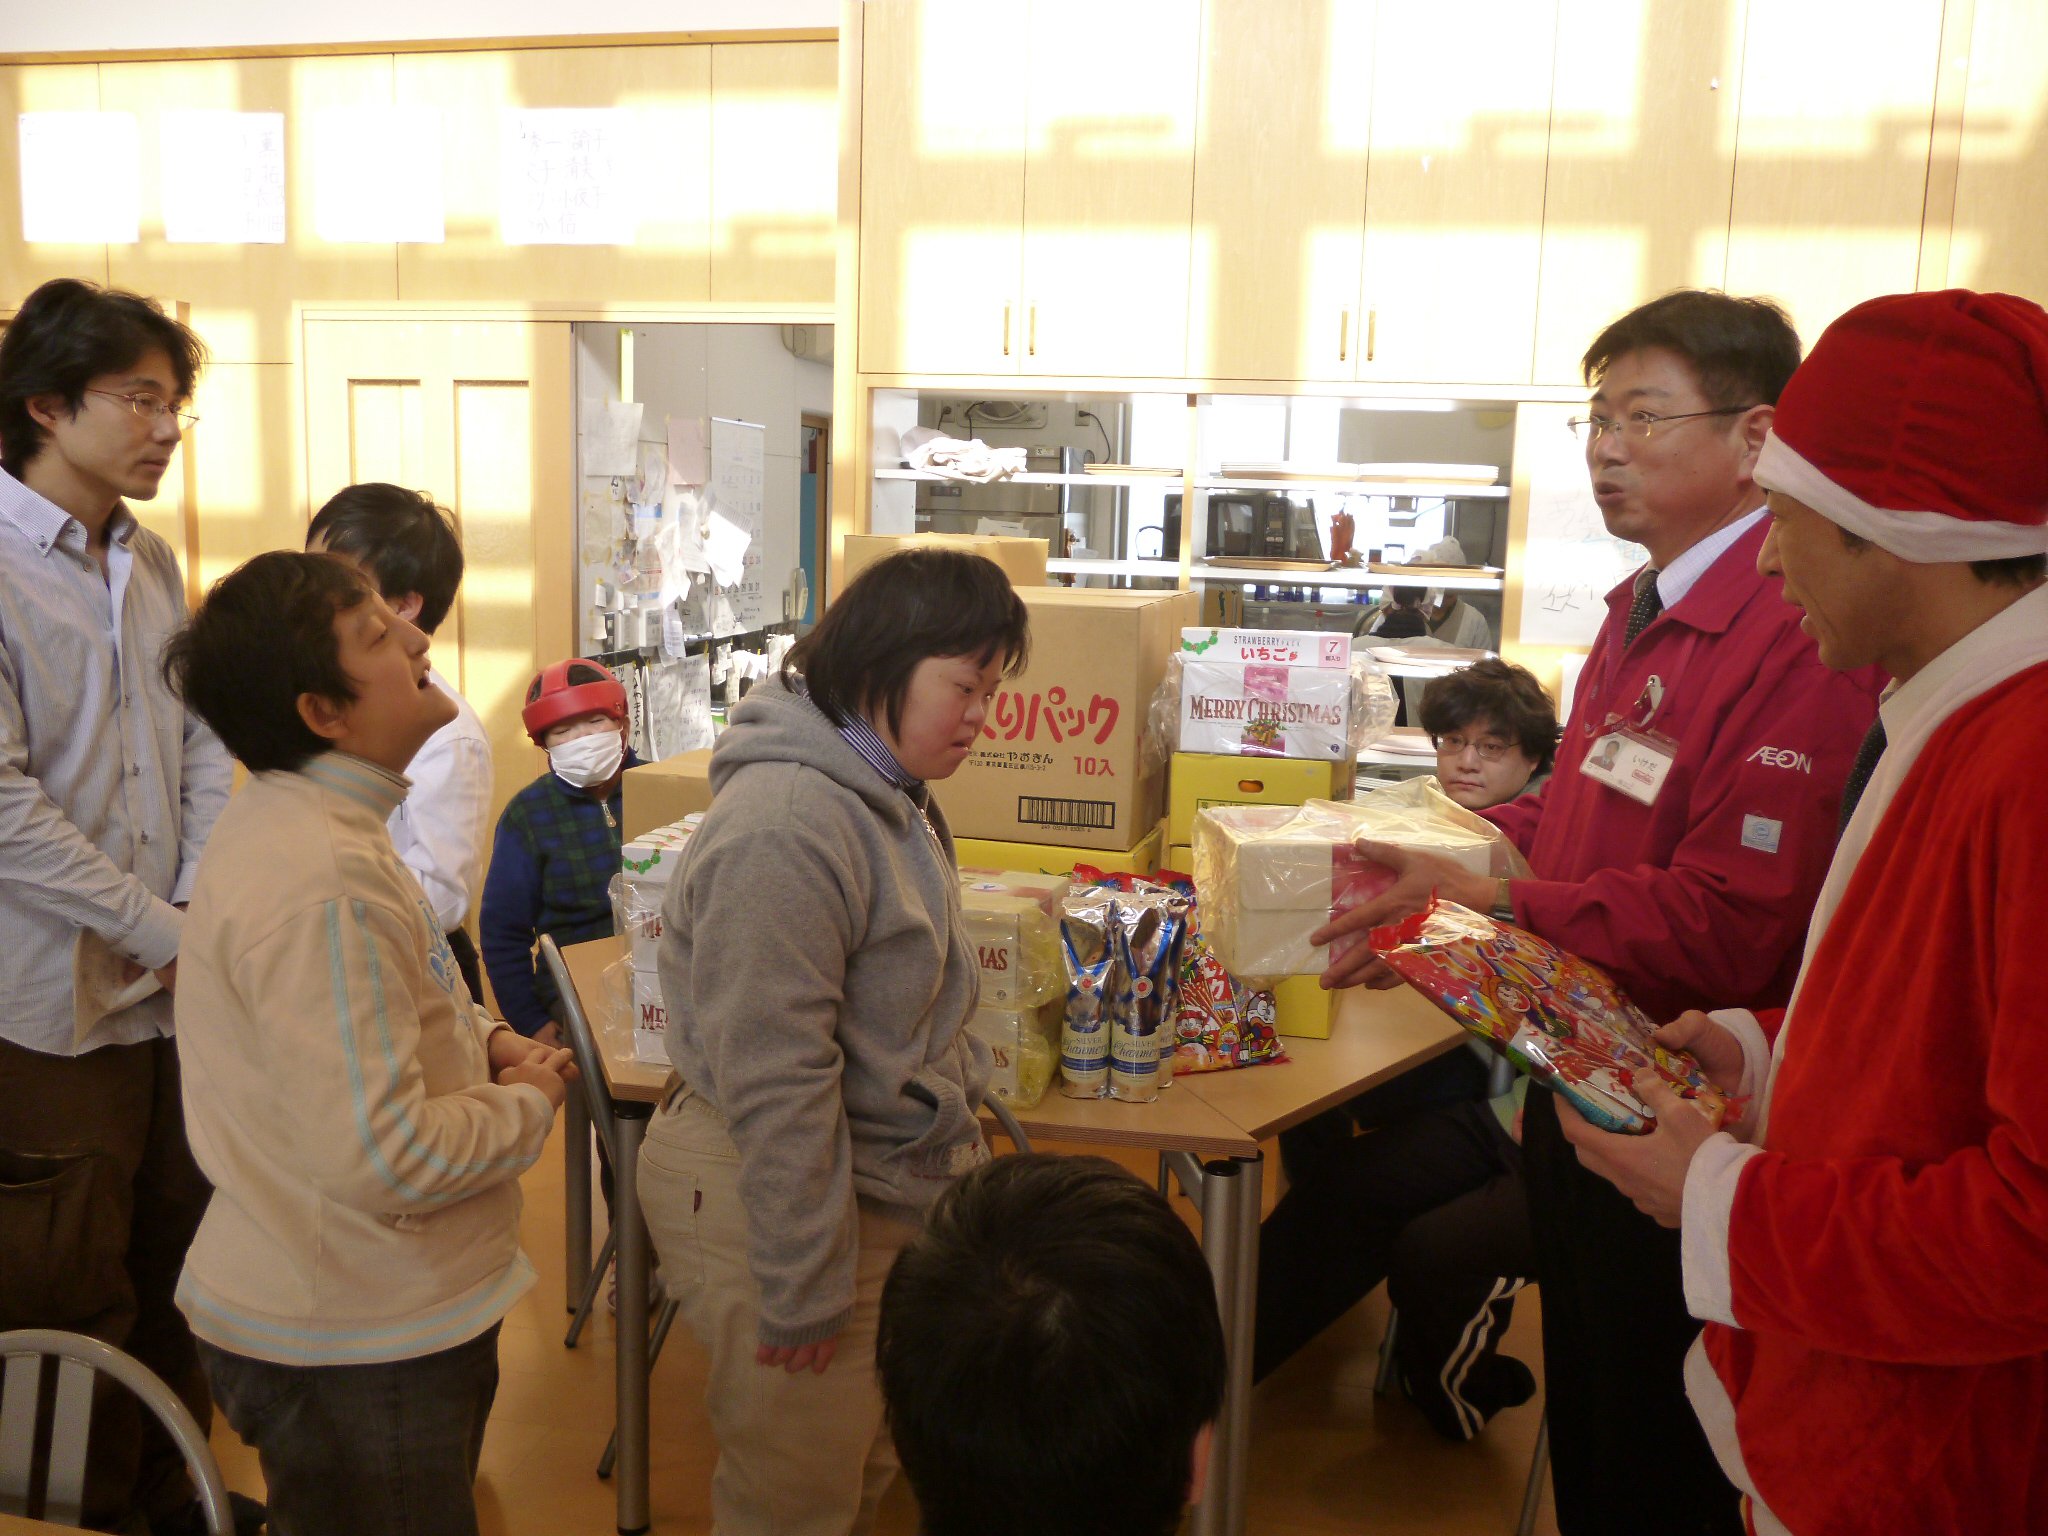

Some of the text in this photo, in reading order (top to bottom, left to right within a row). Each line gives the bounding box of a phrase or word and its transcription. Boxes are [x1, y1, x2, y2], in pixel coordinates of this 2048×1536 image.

[1233, 634, 1280, 647] STRAWBERRY
[1328, 641, 1339, 653] 7
[1240, 646, 1288, 662] いちご
[982, 685, 1121, 745] りパック
[1189, 694, 1342, 726] MERRY CHRISTMAS
[1072, 755, 1116, 778] 10入
